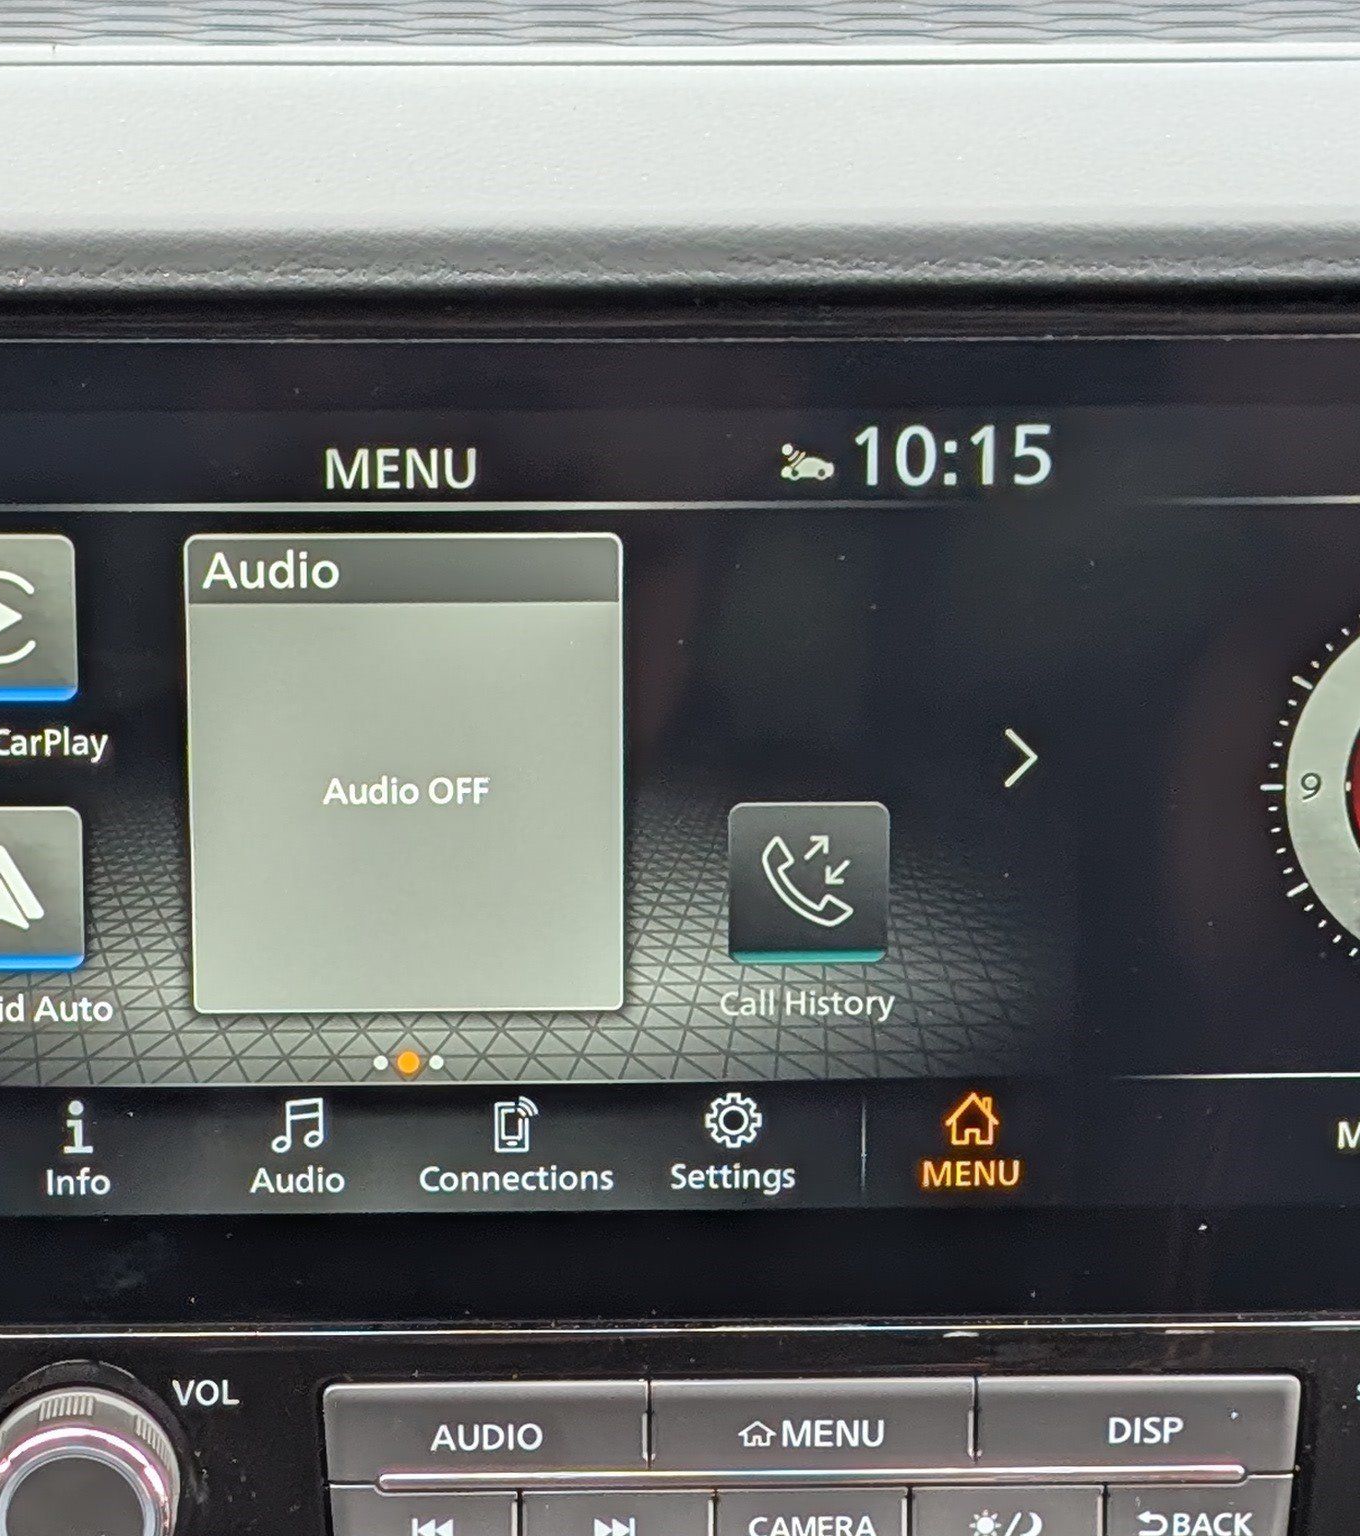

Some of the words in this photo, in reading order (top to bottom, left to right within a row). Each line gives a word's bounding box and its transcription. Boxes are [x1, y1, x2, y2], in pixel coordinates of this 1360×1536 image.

[324, 447, 477, 491] MENU
[853, 424, 1054, 486] 10:15
[202, 549, 340, 591] Audio
[322, 775, 420, 806] Audio
[428, 776, 491, 805] OFF
[1299, 772, 1321, 800] 9
[33, 996, 113, 1022] Auto
[720, 990, 775, 1018] Call
[784, 989, 895, 1022] History
[46, 1168, 111, 1197] Info
[250, 1165, 345, 1195] Audio
[419, 1164, 614, 1193] Connections
[670, 1162, 796, 1196] Settings
[922, 1159, 1019, 1188] MENU
[173, 1381, 238, 1407] VOL
[430, 1423, 543, 1452] AUDIO
[781, 1418, 885, 1448] MENU
[1108, 1417, 1184, 1444] DISP
